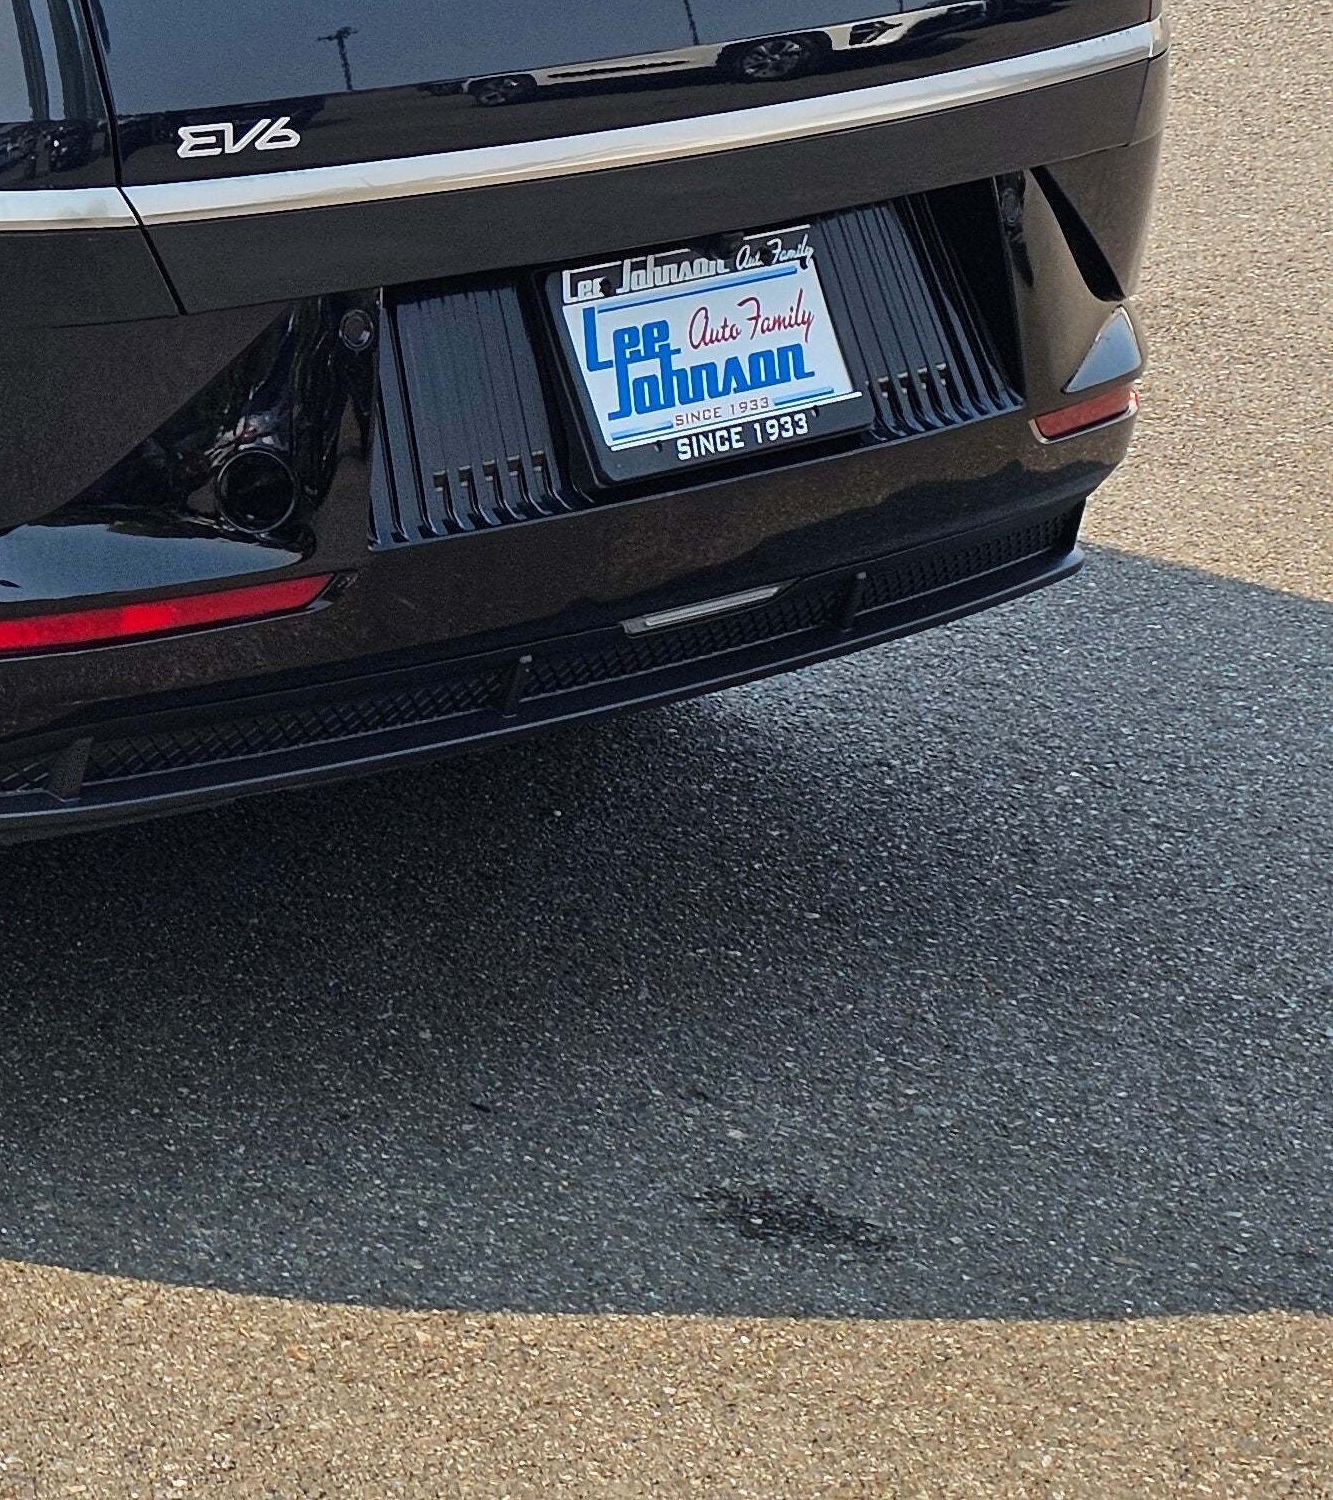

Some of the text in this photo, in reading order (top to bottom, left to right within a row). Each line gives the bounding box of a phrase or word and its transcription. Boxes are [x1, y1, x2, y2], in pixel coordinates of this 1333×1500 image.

[176, 116, 301, 159] EV6
[616, 255, 731, 295] Johnson
[767, 233, 815, 266] Family
[582, 306, 681, 372] Lee
[688, 289, 815, 350] Auto Family
[608, 343, 815, 421] Johnson
[675, 396, 769, 427] SINCE 1933
[676, 412, 809, 461] SINCE 1933
